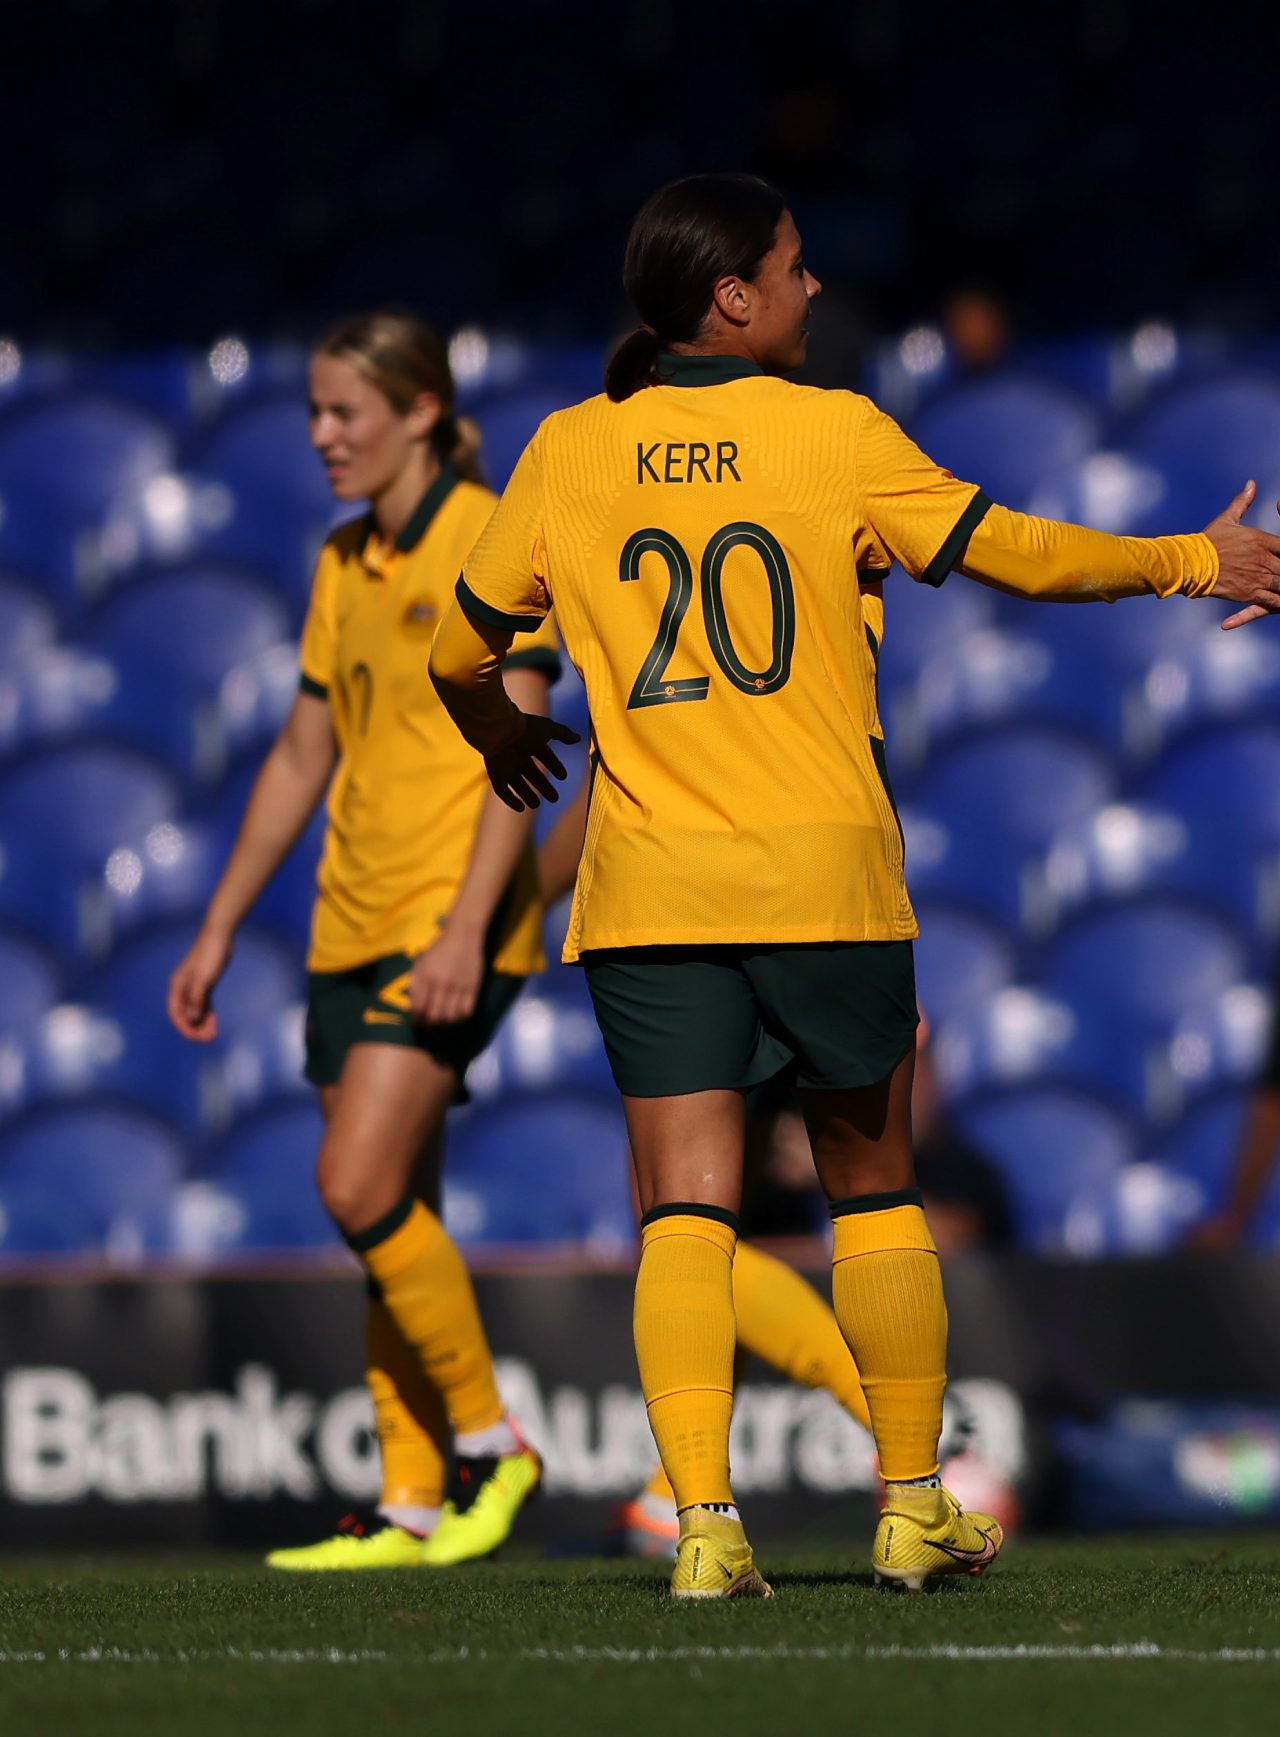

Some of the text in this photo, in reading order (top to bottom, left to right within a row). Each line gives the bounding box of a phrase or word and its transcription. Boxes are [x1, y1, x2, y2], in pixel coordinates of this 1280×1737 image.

[636, 440, 743, 485] KERR
[618, 520, 796, 710] 20
[2, 1362, 318, 1502] Bank
